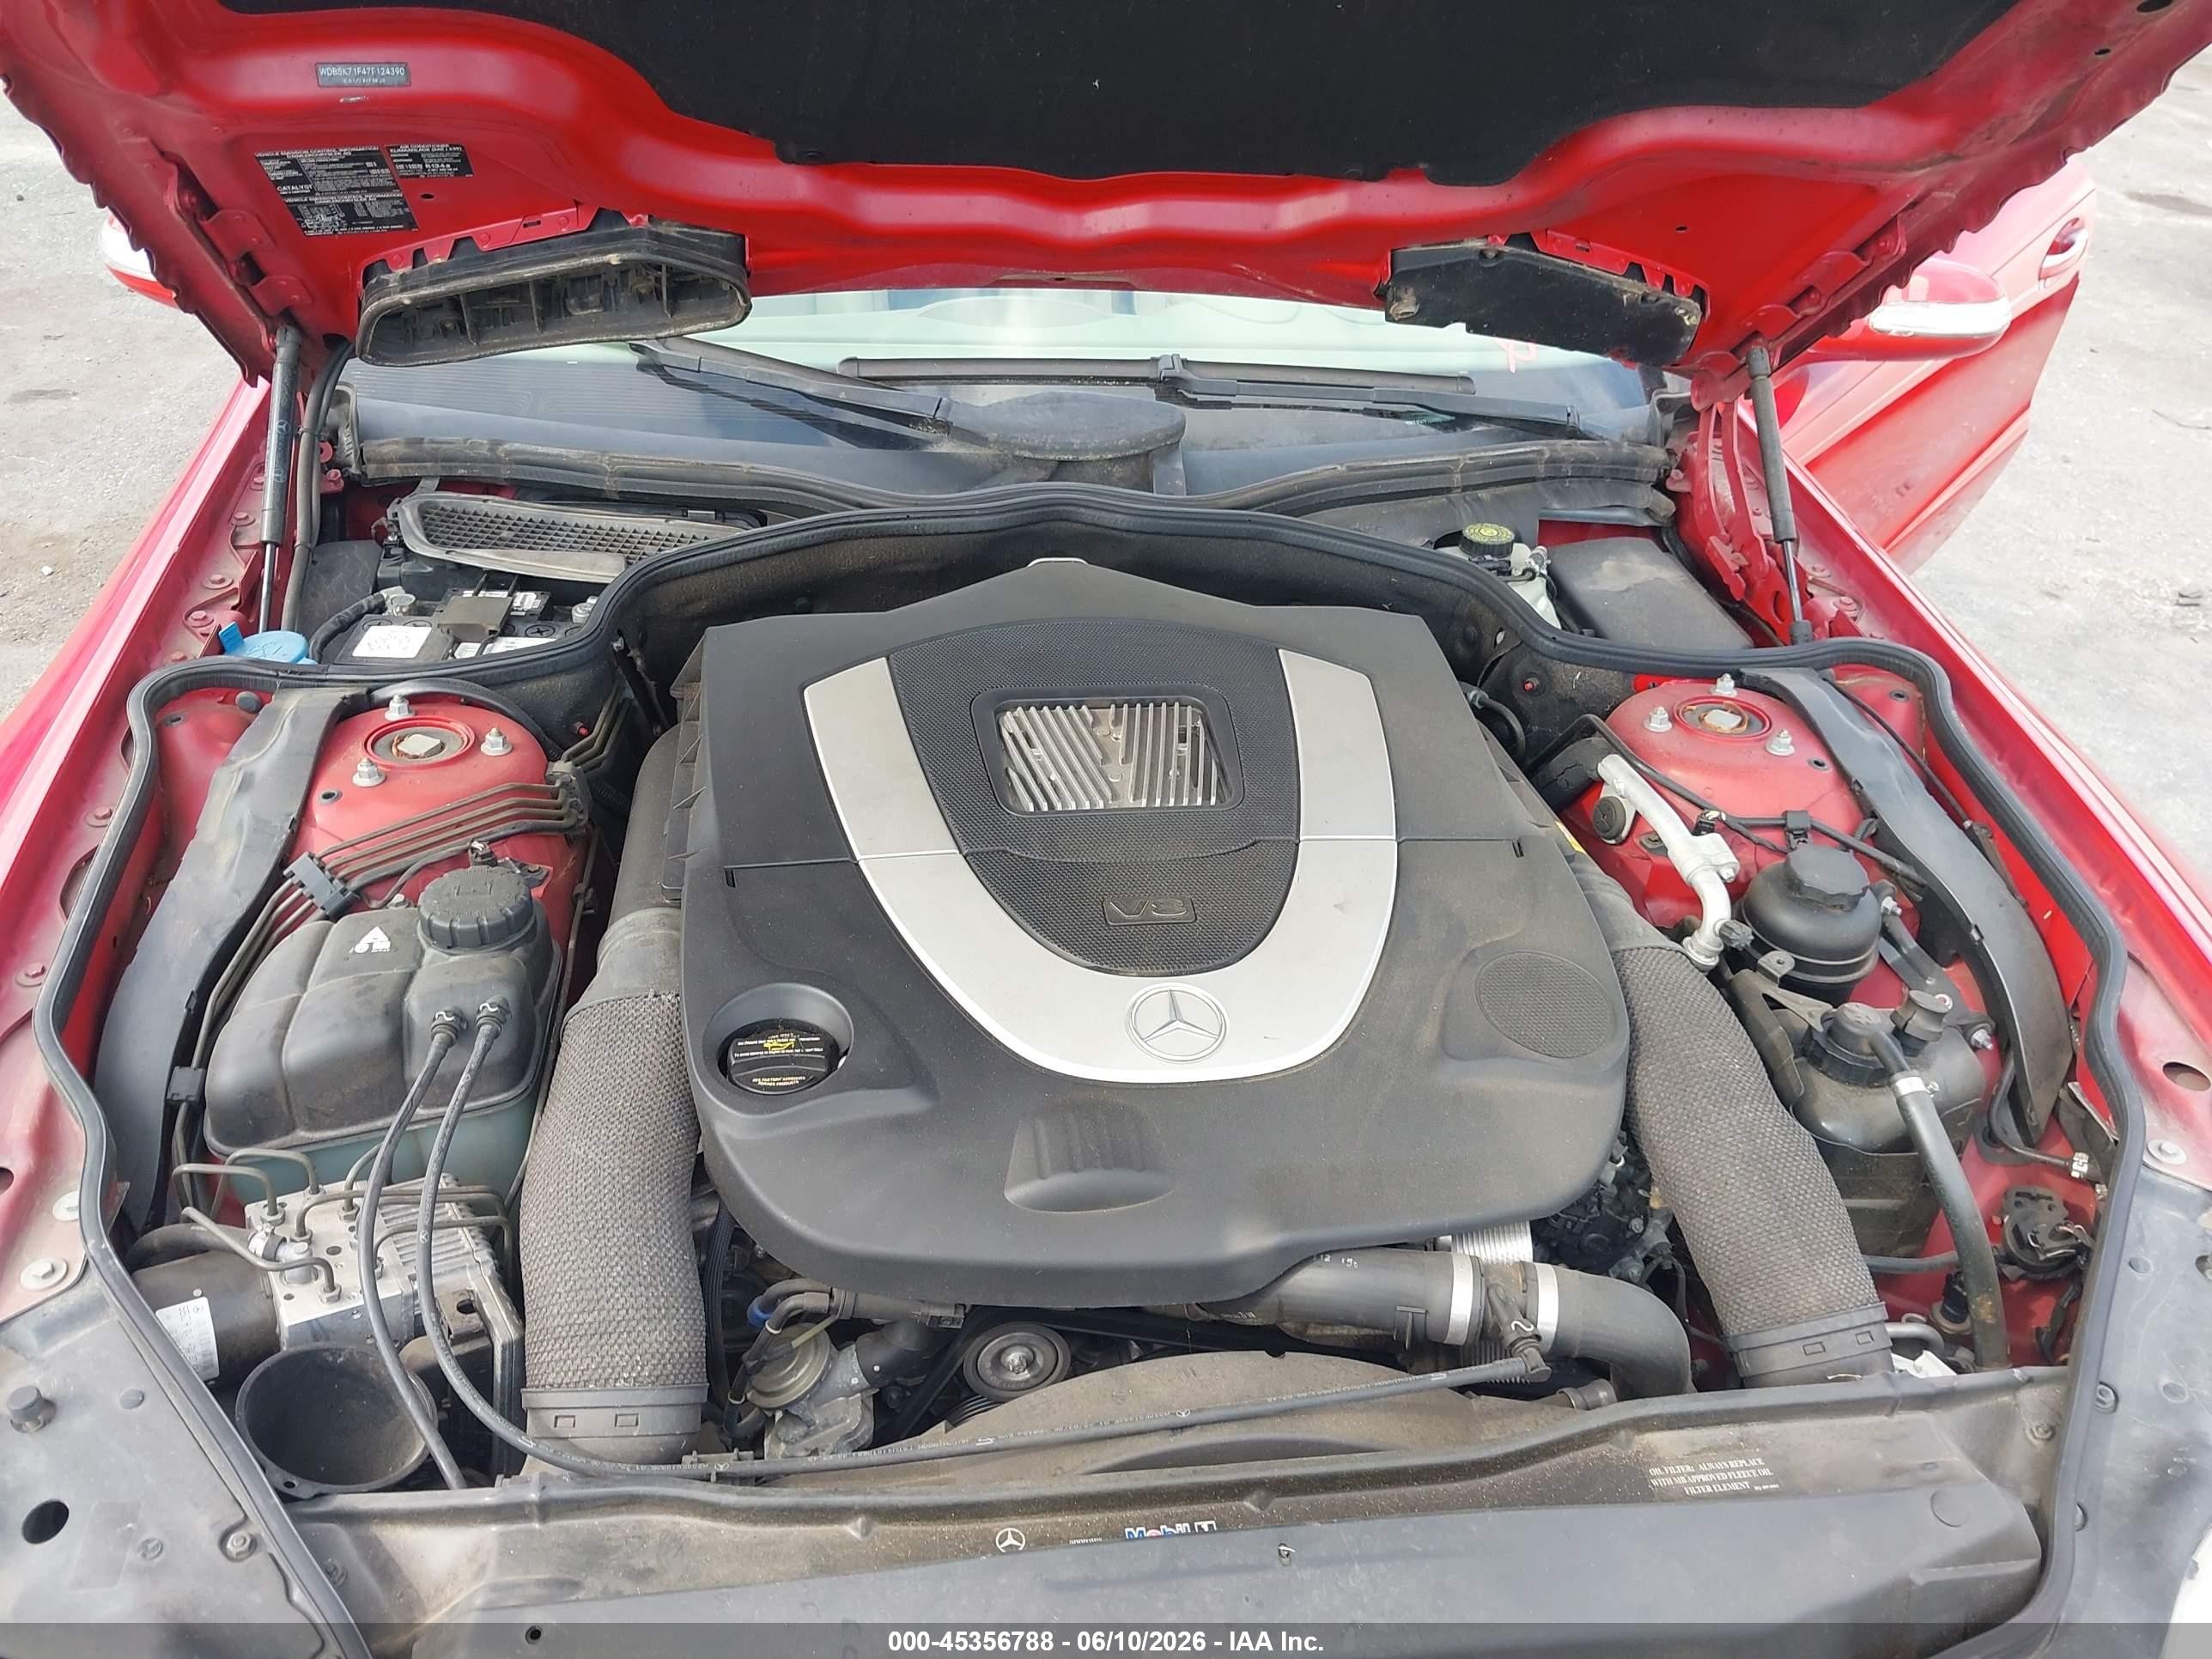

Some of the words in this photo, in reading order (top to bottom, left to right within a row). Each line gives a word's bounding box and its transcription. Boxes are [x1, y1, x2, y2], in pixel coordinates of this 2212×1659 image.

[1109, 898, 1188, 919] V8
[1649, 1467, 1663, 1476] OIL
[1698, 1461, 1729, 1472] ALWAYS
[1729, 1457, 1765, 1469] REPLACE
[1650, 1477, 1675, 1488] WITH
[1687, 1472, 1728, 1485] APPROVED
[1728, 1469, 1759, 1480] FLEECE
[1758, 1467, 1774, 1477] OIL
[1683, 1485, 1713, 1496] FILTER
[1713, 1480, 1751, 1492] ELEMENT
